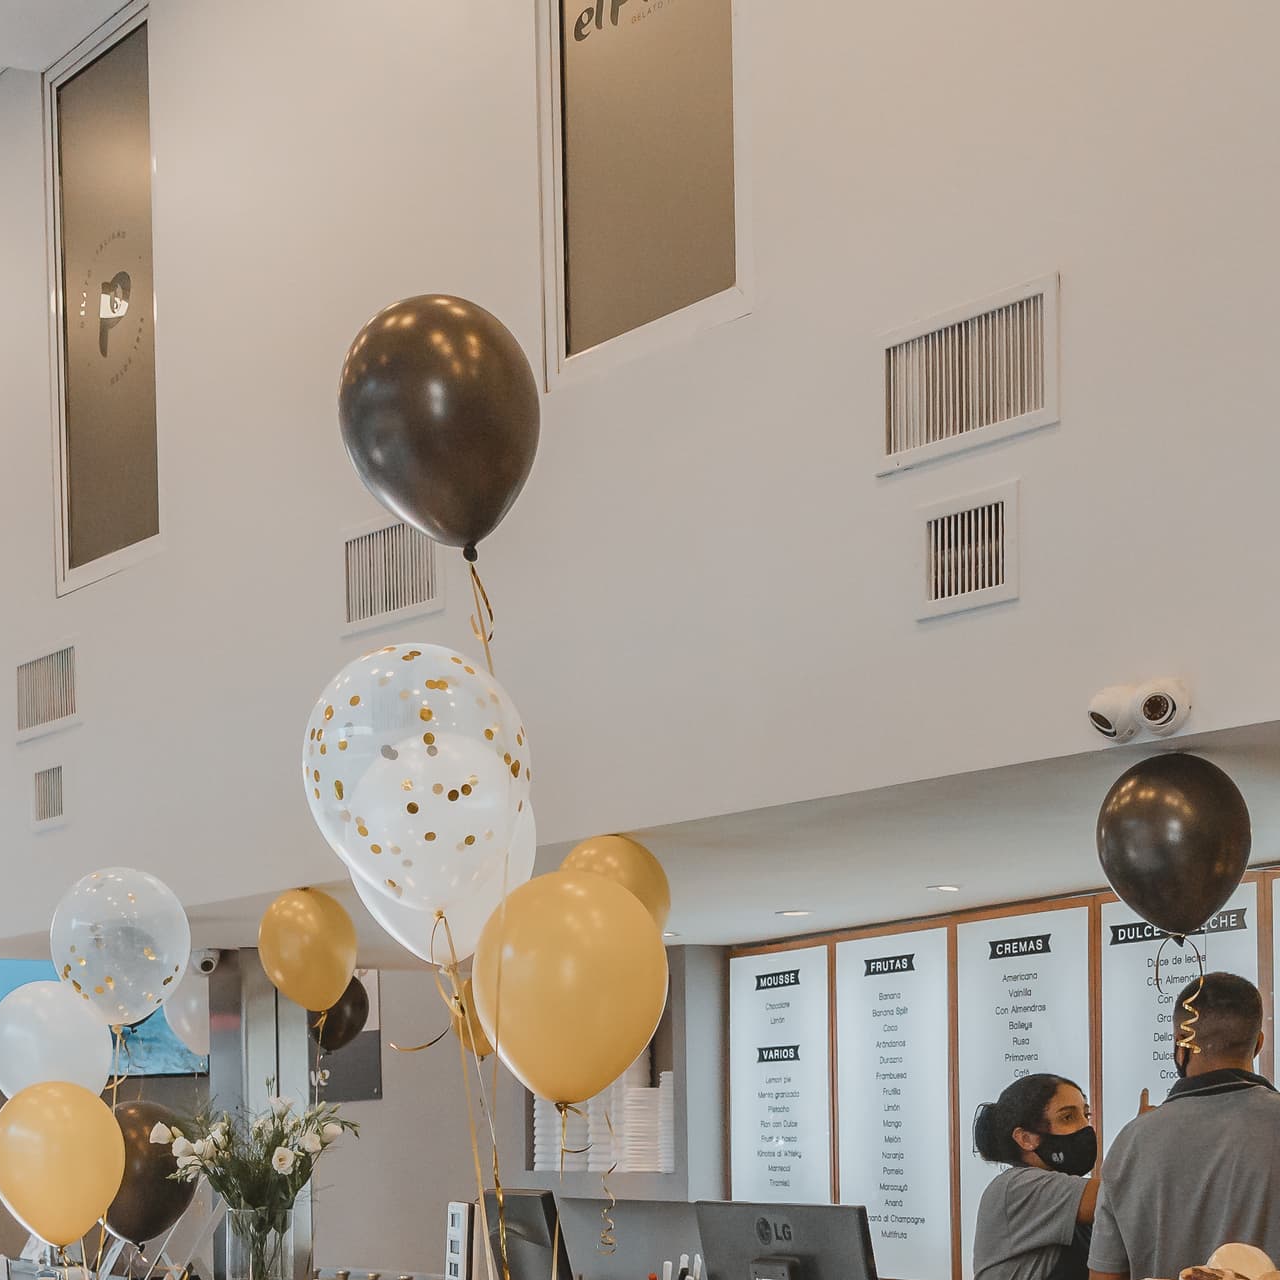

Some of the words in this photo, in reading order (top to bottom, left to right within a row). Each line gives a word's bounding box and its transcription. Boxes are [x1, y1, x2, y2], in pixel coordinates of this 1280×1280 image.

[1117, 926, 1161, 941] DULCE
[995, 939, 1043, 955] CREMAS
[870, 958, 908, 972] FRUTAS
[1147, 956, 1169, 967] Duce
[1172, 956, 1182, 965] de
[1184, 954, 1206, 964] lece
[760, 973, 796, 987] MOUSSE
[1002, 971, 1038, 982] Americana
[878, 992, 901, 1001] Banana
[1008, 987, 1032, 998] Vainilla
[872, 1008, 894, 1018] Banana
[995, 1006, 1008, 1015] Con
[1011, 1003, 1046, 1014] Almendras
[883, 1023, 898, 1032] Coco
[1009, 1021, 1033, 1031] Baileys
[1012, 1037, 1030, 1046] Rusa
[762, 1048, 795, 1060] VARIOS
[1004, 1053, 1039, 1062] Primavera
[876, 1072, 907, 1081] Frambuesa
[882, 1087, 901, 1096] Frutilla
[882, 1119, 902, 1129] Mango
[882, 1151, 904, 1161] Naranja
[890, 1214, 926, 1225] Champagne
[880, 1230, 908, 1240] Multifruta
